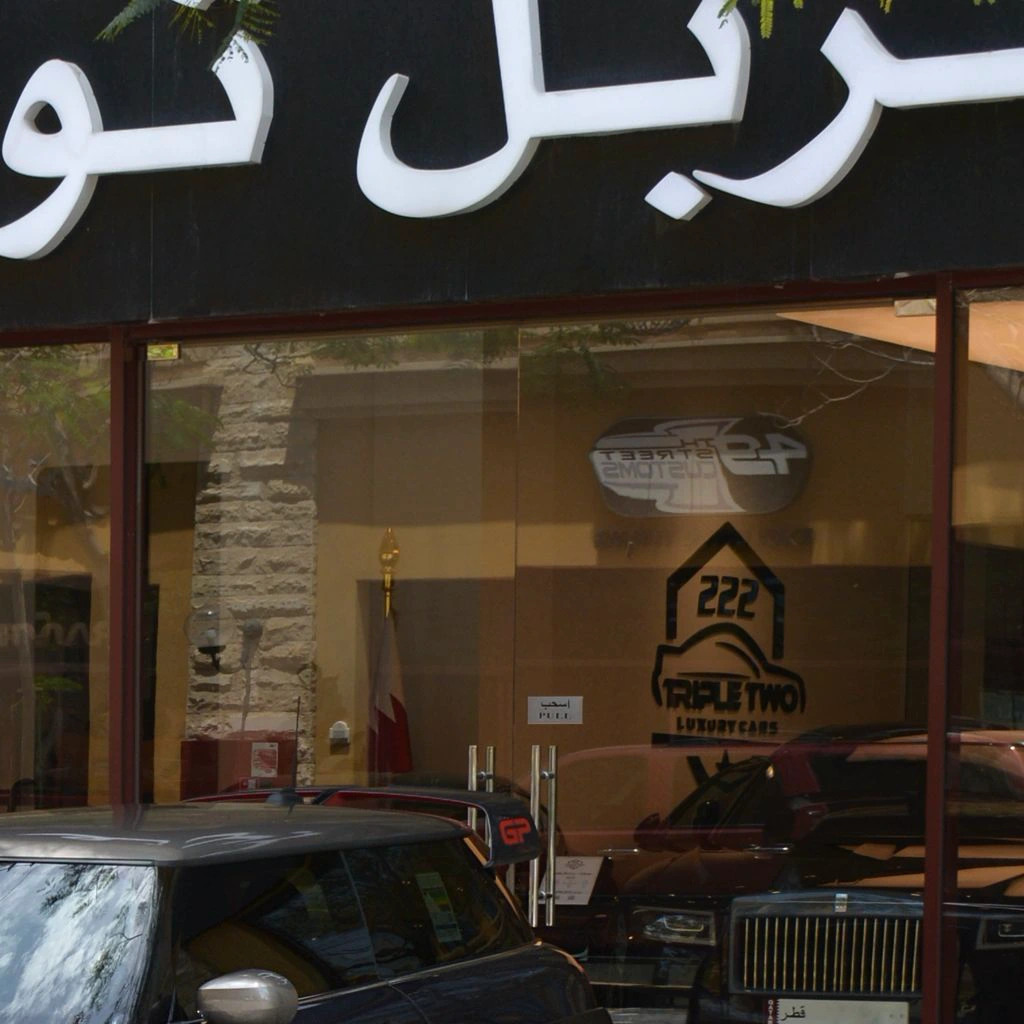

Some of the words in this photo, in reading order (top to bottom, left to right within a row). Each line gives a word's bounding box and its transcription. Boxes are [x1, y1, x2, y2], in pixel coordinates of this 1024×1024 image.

[697, 575, 760, 619] 222
[662, 677, 743, 712] TRIPLE
[744, 680, 800, 714] TWO
[676, 716, 736, 734] LUXURY
[738, 718, 779, 735] CARS
[498, 817, 532, 846] GP
